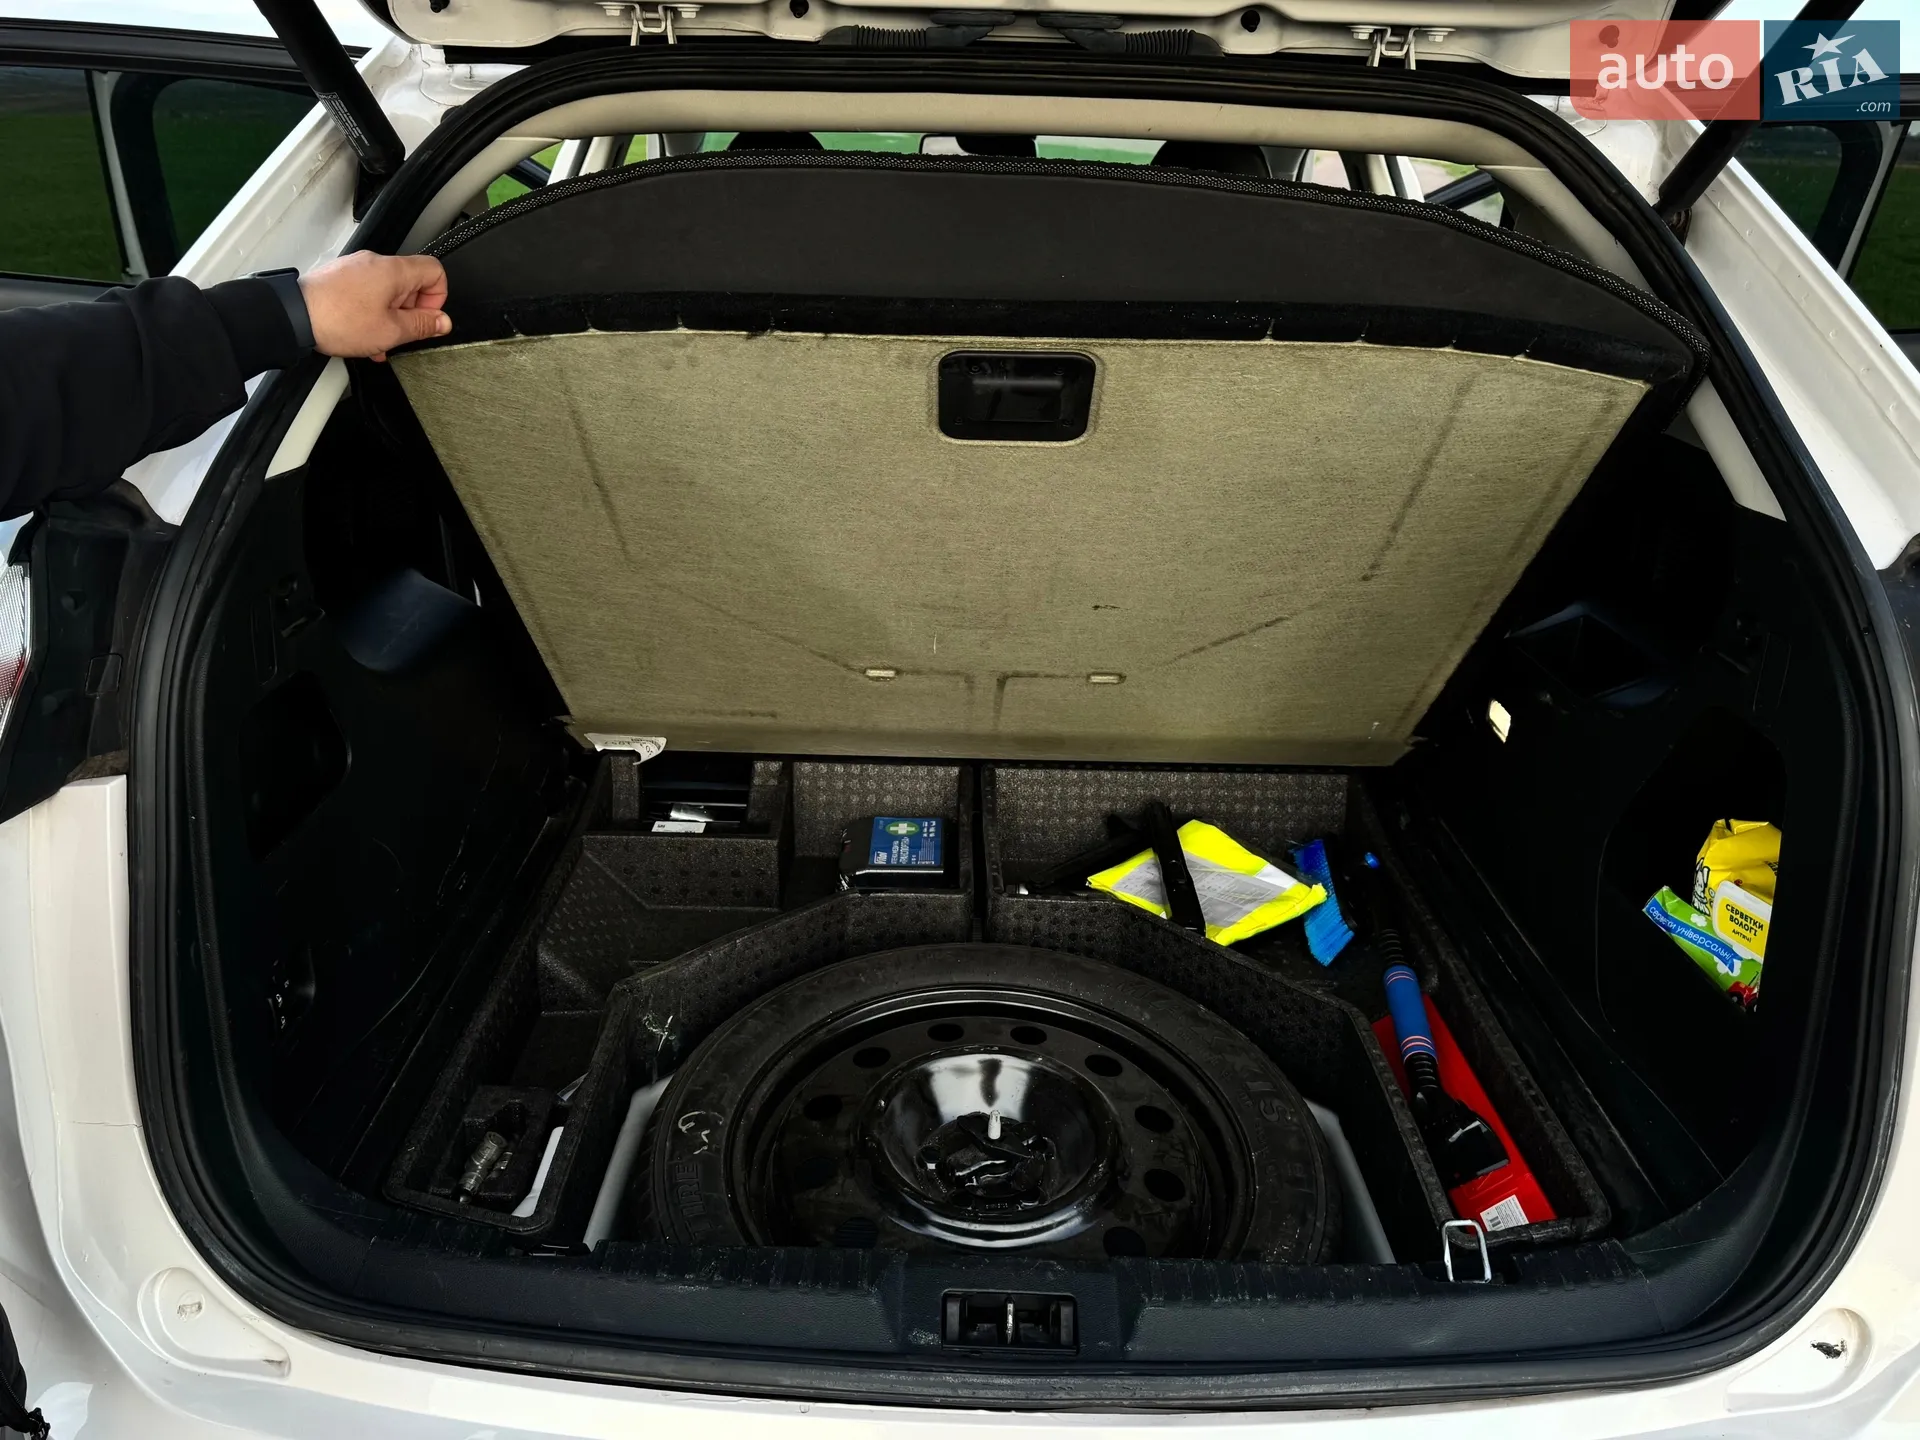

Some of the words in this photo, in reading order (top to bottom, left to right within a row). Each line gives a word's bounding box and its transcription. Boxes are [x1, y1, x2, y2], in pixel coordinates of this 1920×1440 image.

[1725, 903, 1763, 931] СЕРВЕТКИ
[1729, 914, 1757, 937] ВОЛОГІ
[1675, 925, 1734, 961] універсальні
